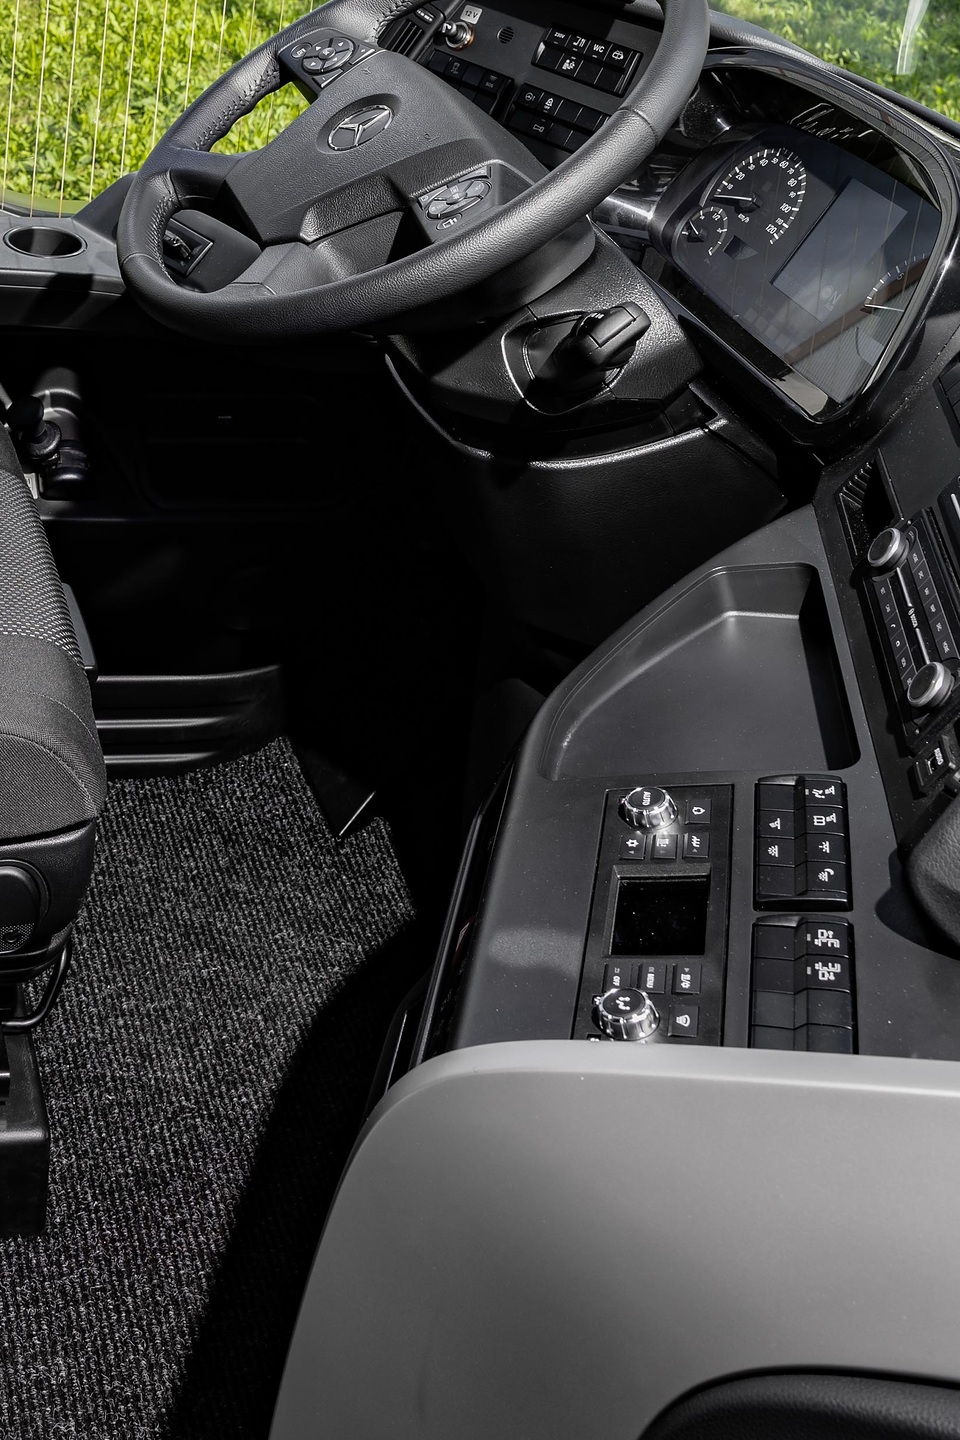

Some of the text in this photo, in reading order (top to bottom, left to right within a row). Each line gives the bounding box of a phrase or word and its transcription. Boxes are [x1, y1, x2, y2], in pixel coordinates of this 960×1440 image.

[593, 43, 605, 53] WC
[759, 158, 769, 167] 40
[771, 157, 779, 165] 50
[779, 160, 789, 169] 60
[747, 163, 756, 171] 30
[787, 167, 795, 175] 70
[735, 172, 746, 181] 20
[787, 178, 798, 187] 80
[779, 202, 792, 214] 100
[737, 213, 750, 224] km/h
[765, 223, 778, 235] 120
[642, 791, 651, 806] AUTO
[612, 975, 621, 987] OFF
[646, 973, 655, 989] MENU
